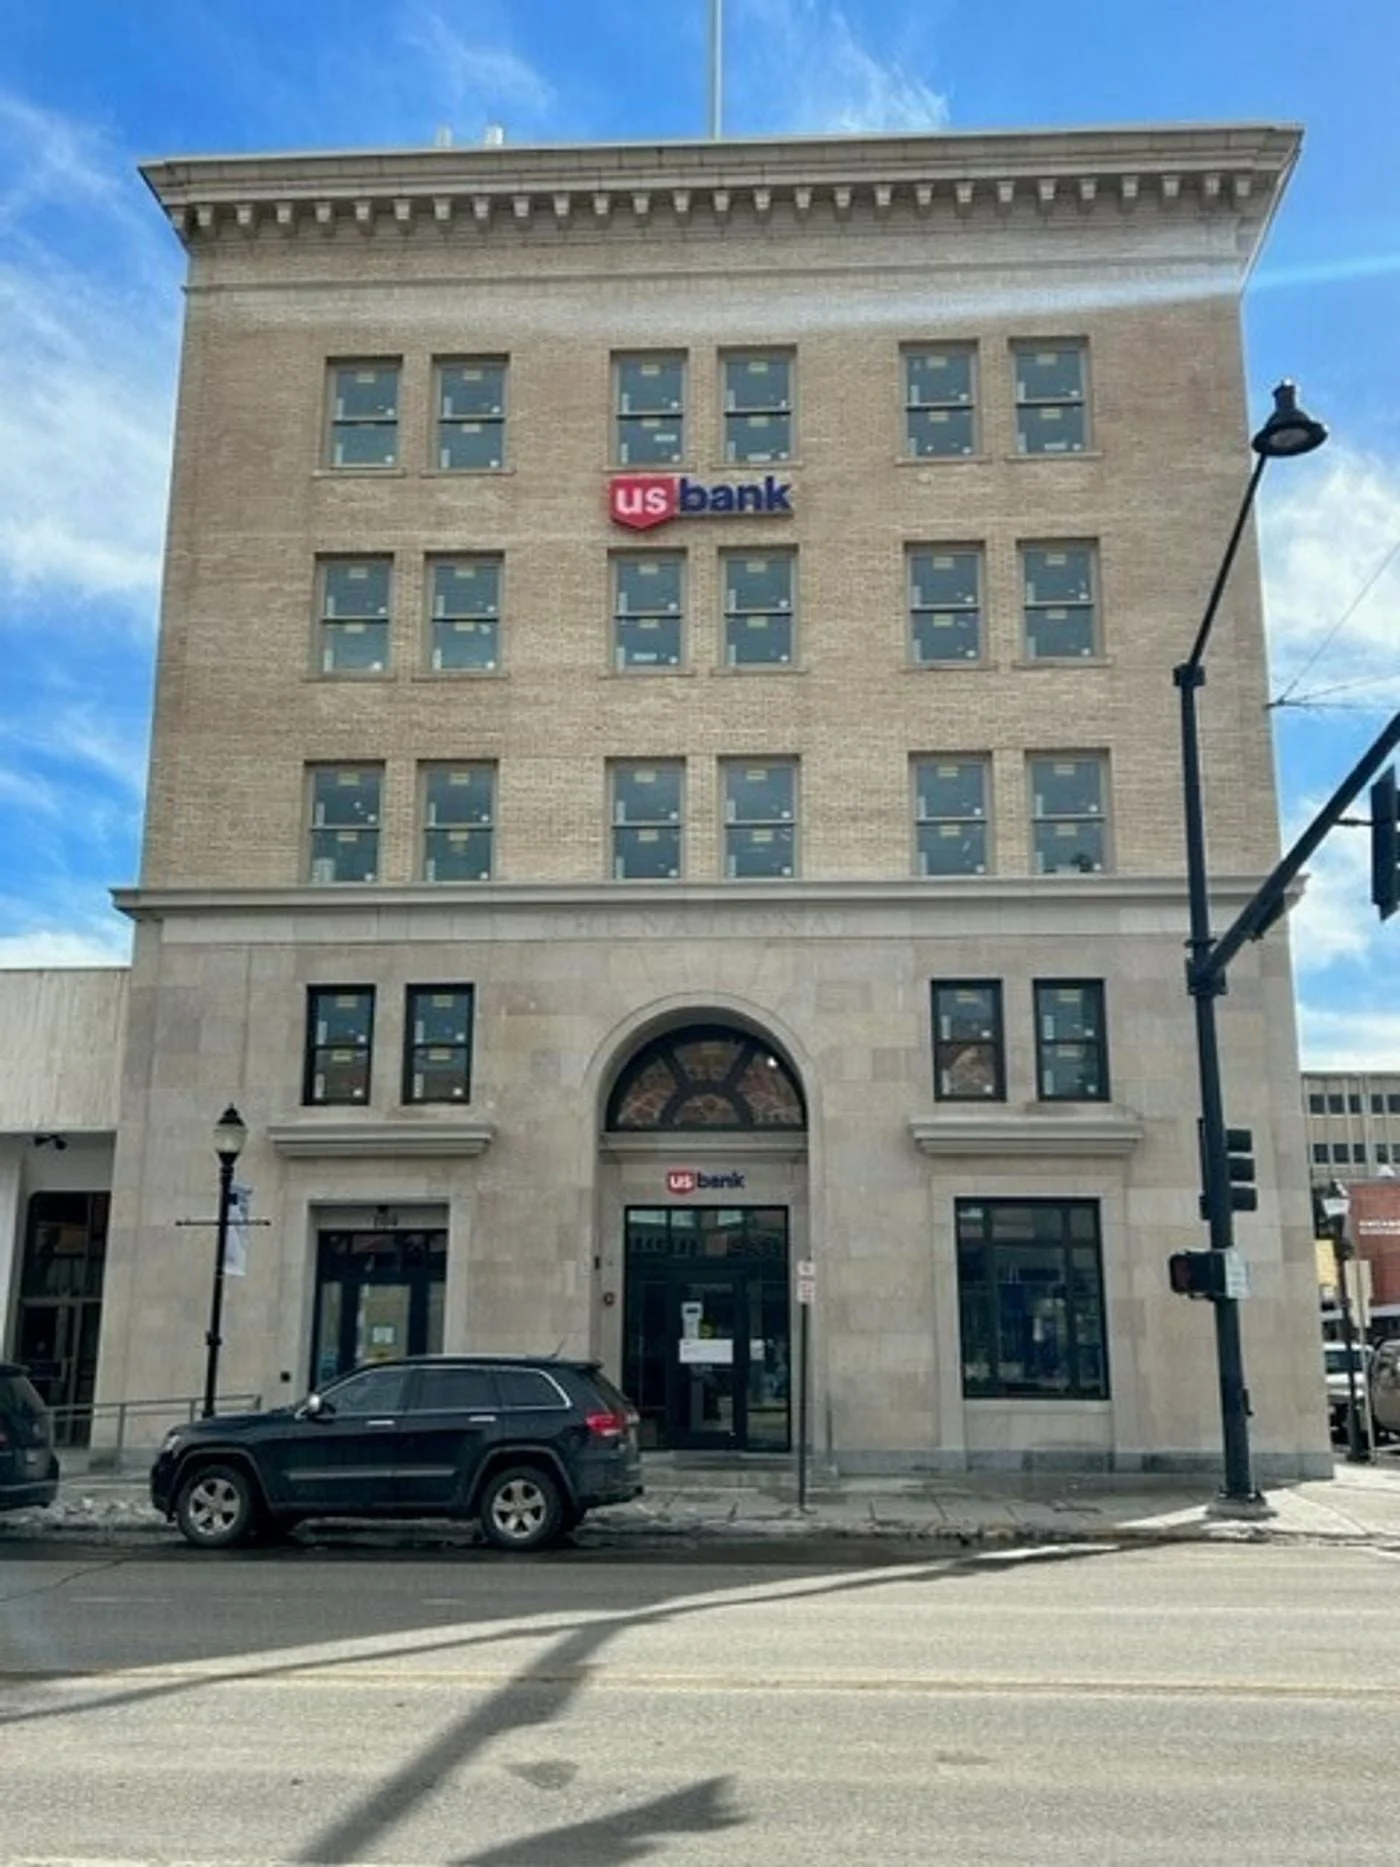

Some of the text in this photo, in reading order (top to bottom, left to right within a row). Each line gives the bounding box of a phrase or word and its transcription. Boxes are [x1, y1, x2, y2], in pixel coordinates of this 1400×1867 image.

[615, 475, 792, 515] us bank
[670, 1170, 745, 1190] us bank
